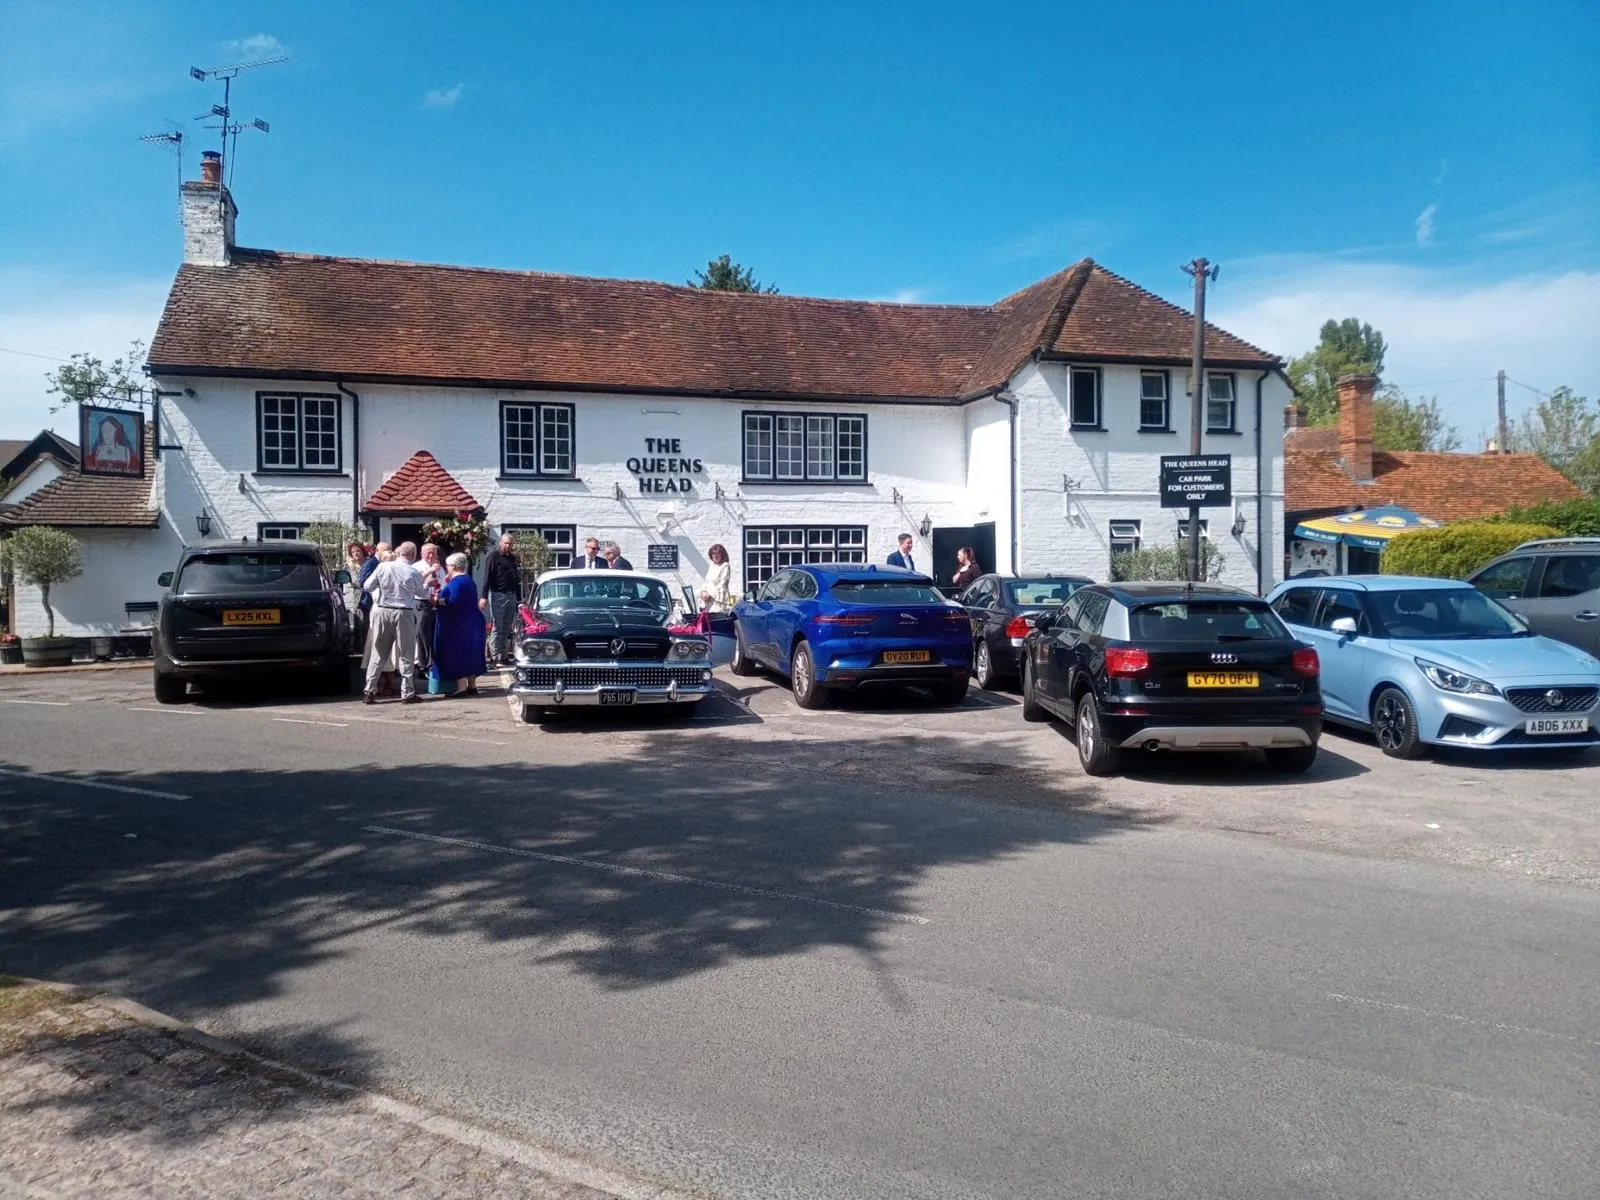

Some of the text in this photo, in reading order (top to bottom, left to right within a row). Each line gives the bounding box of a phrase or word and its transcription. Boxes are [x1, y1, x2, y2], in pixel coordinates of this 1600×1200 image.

[645, 438, 681, 453] THE
[626, 457, 703, 474] QUEENS
[1179, 460, 1207, 468] QUEENS
[639, 478, 692, 492] HEAD
[227, 612, 274, 622] LX25 KXL
[1193, 672, 1253, 685] GY70 OPU
[602, 692, 616, 702] 765
[1531, 720, 1583, 732] AB06 XXX
